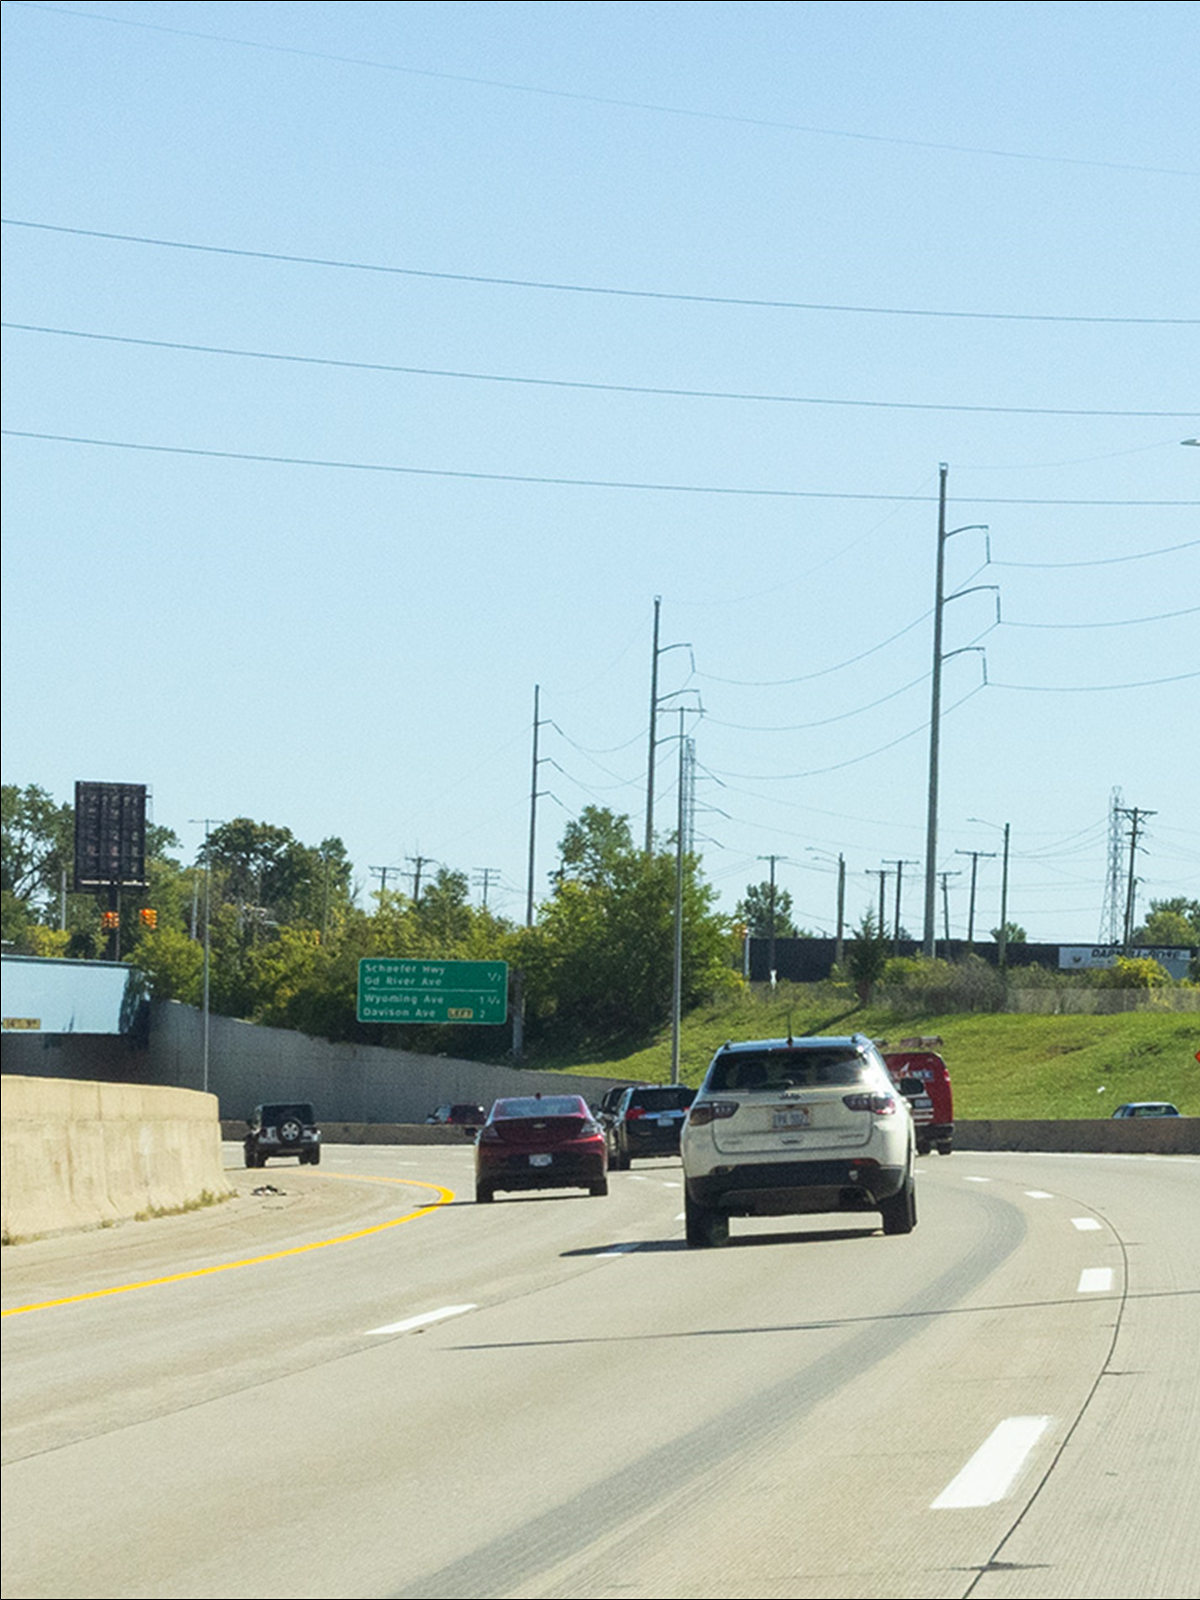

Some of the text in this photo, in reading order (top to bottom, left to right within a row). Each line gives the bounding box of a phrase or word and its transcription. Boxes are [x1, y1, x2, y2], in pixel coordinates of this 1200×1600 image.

[365, 964, 445, 976] Schaefer Hwy
[364, 976, 443, 986] Gd River Ave
[364, 994, 418, 1005] Wyoming
[424, 996, 444, 1005] Ave
[363, 1008, 410, 1017] Davison
[415, 1009, 436, 1018] Ave
